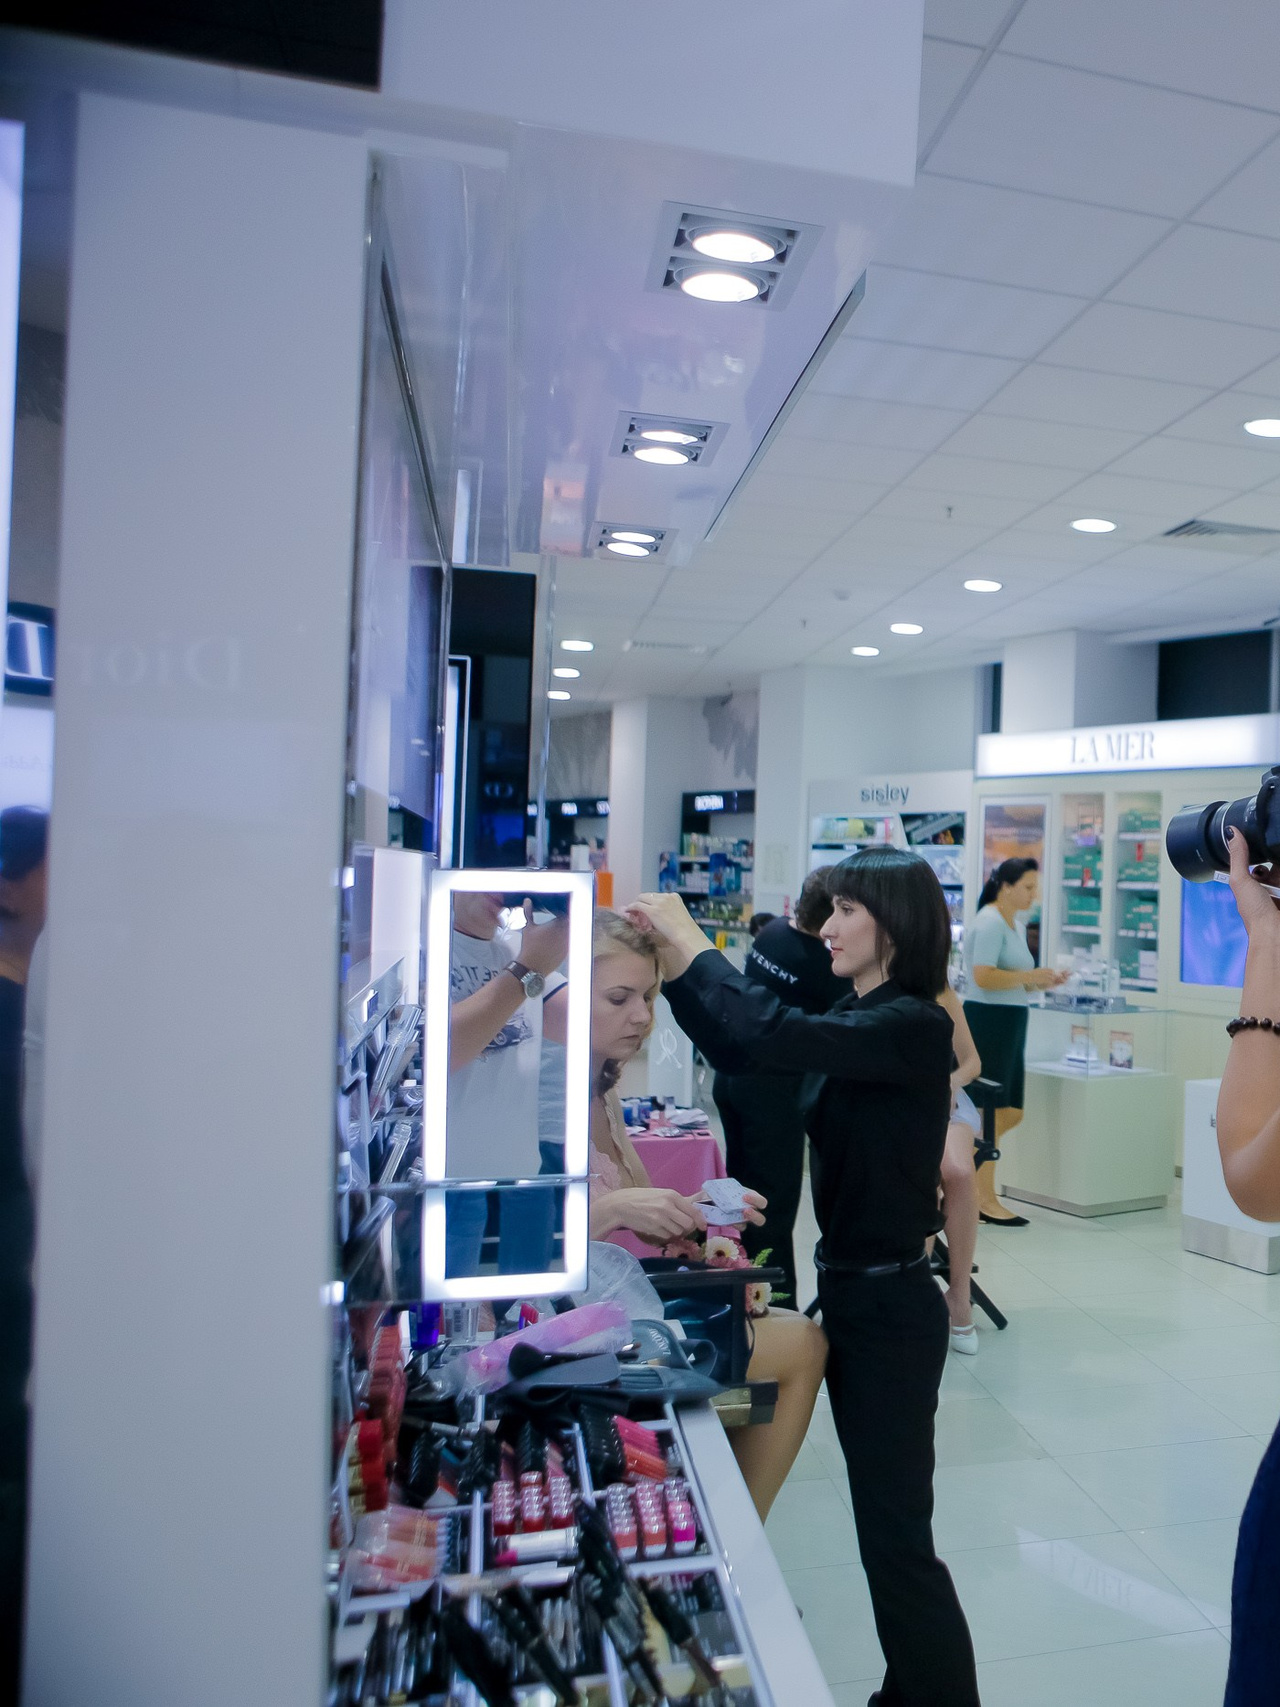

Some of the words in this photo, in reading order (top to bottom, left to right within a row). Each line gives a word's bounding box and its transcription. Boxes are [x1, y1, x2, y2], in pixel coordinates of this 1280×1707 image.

[1070, 734, 1100, 764] LA
[1106, 730, 1156, 762] MER
[861, 784, 909, 805] sisley
[752, 950, 798, 984] VENCHY
